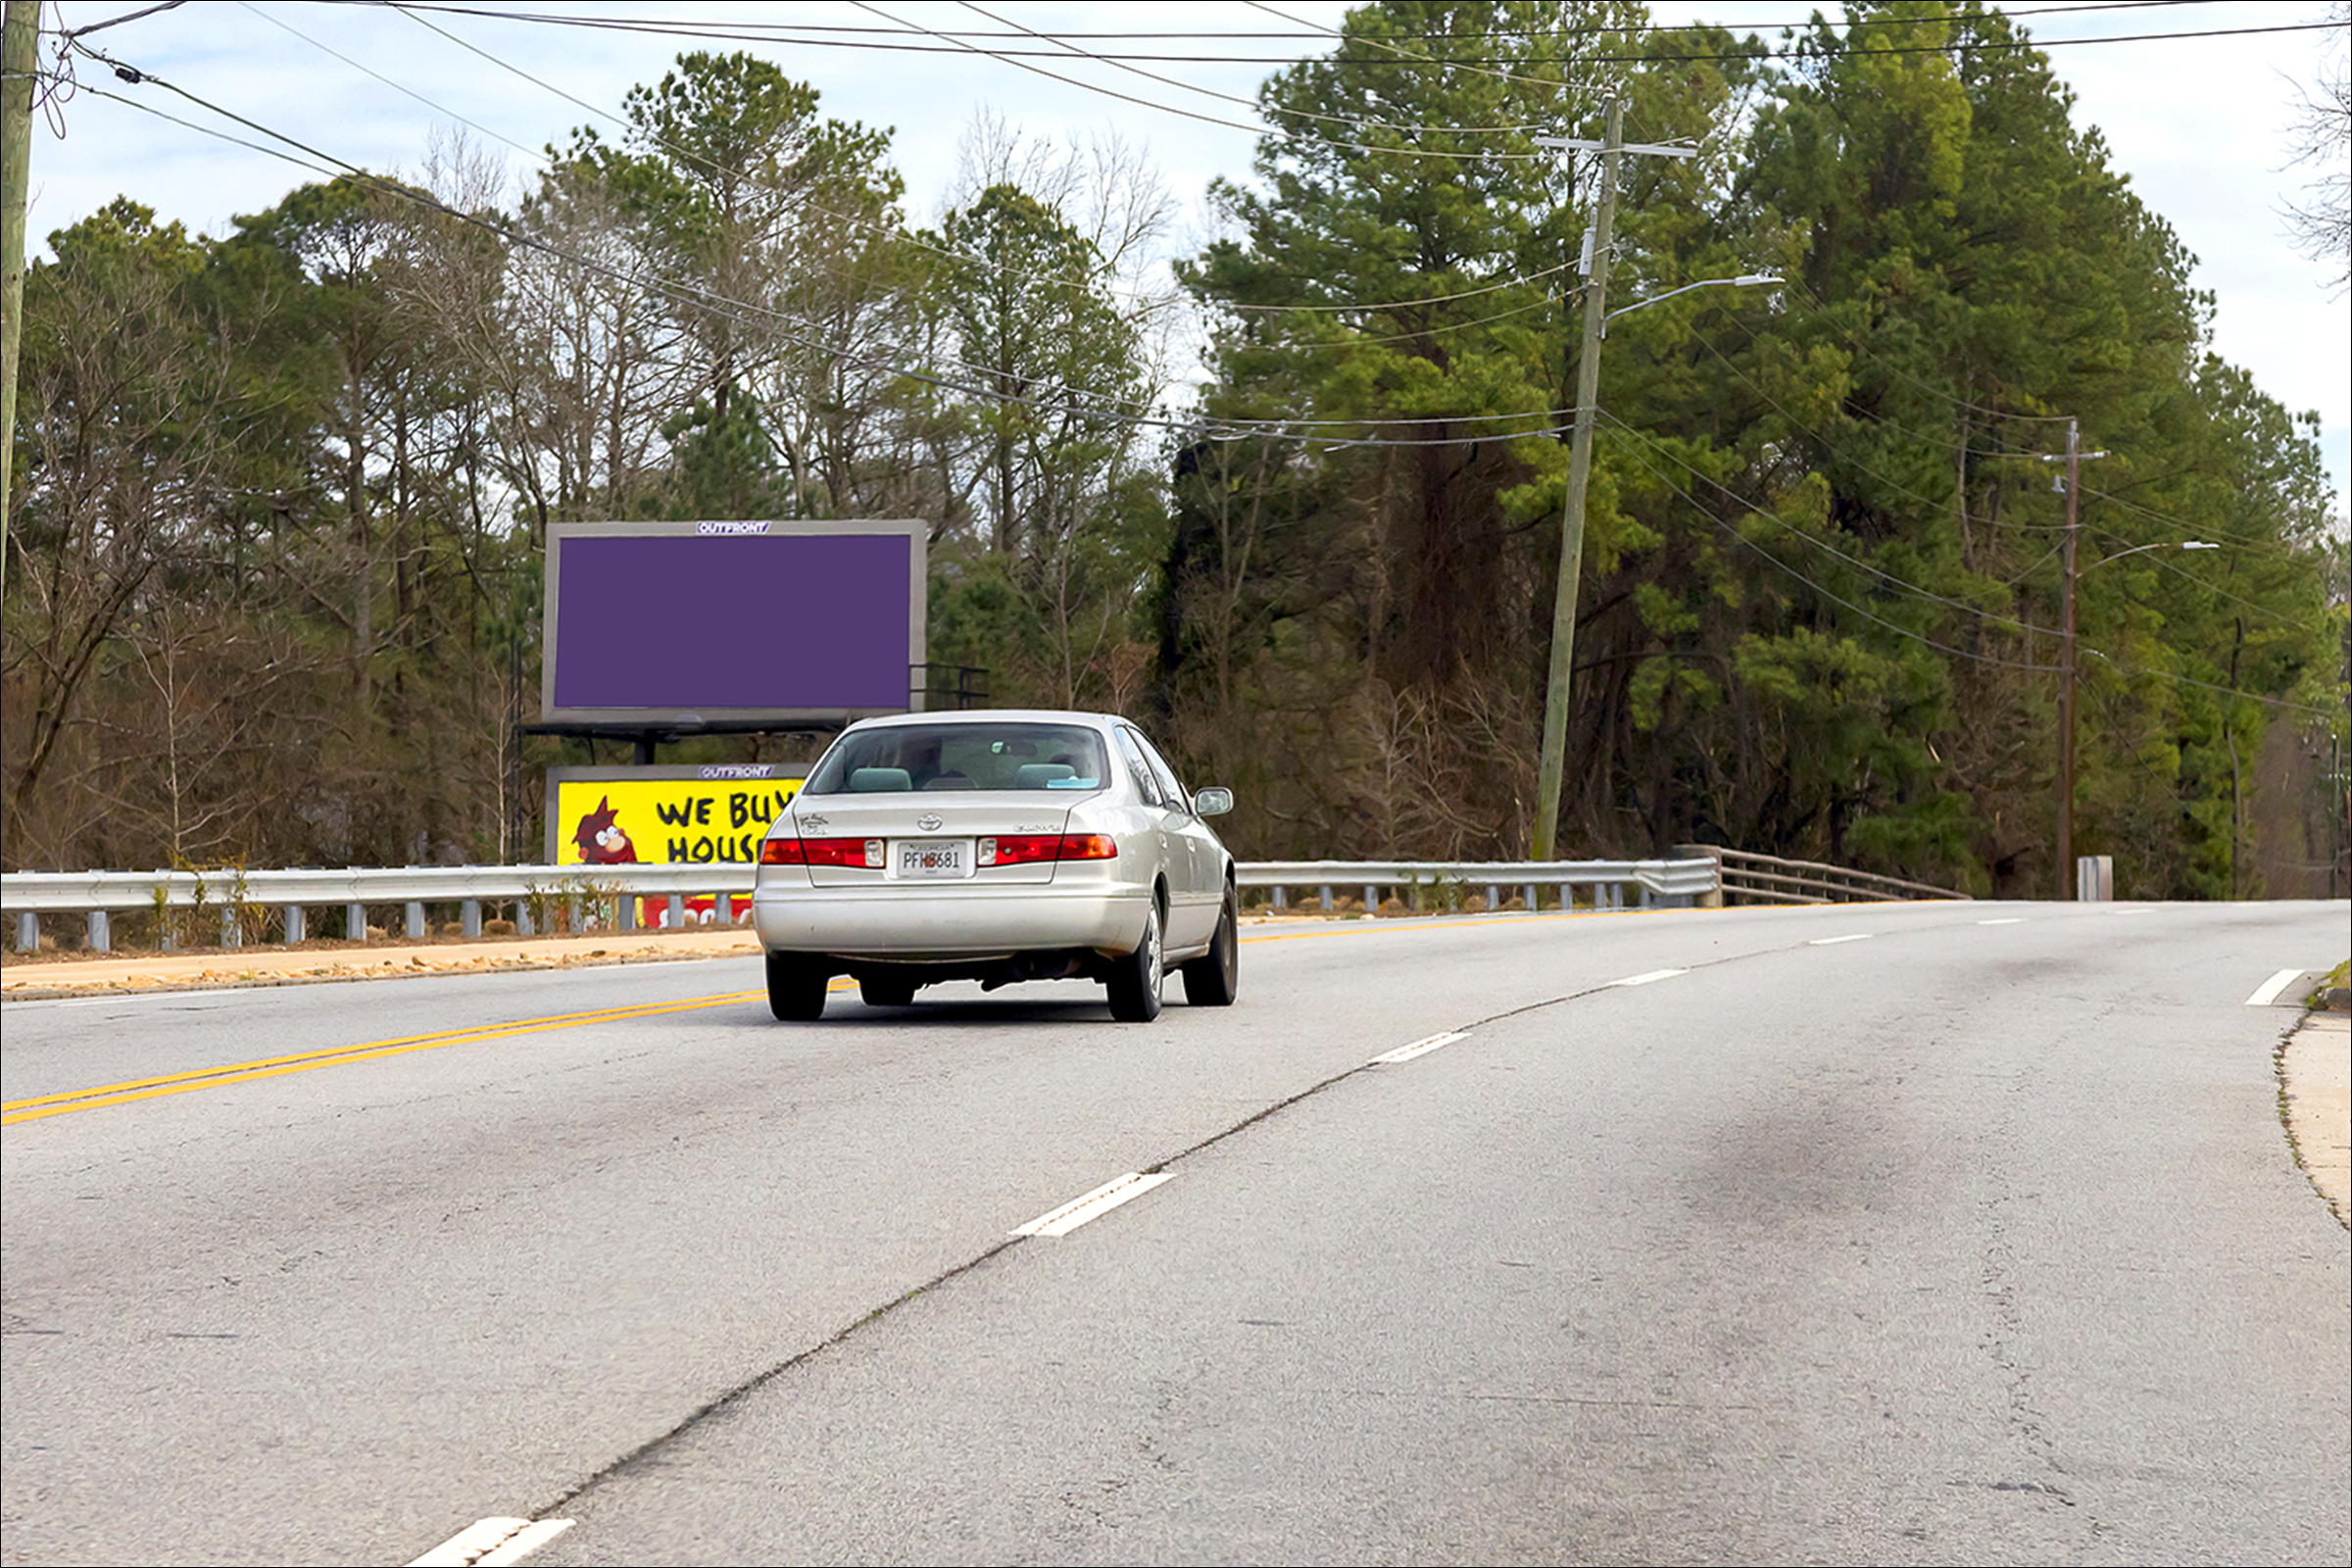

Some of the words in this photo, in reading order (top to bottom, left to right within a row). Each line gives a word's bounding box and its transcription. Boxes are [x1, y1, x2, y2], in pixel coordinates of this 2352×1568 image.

[699, 521, 769, 534] OUTFRONT
[701, 765, 770, 777] OUTFRONT
[657, 797, 714, 827] WE
